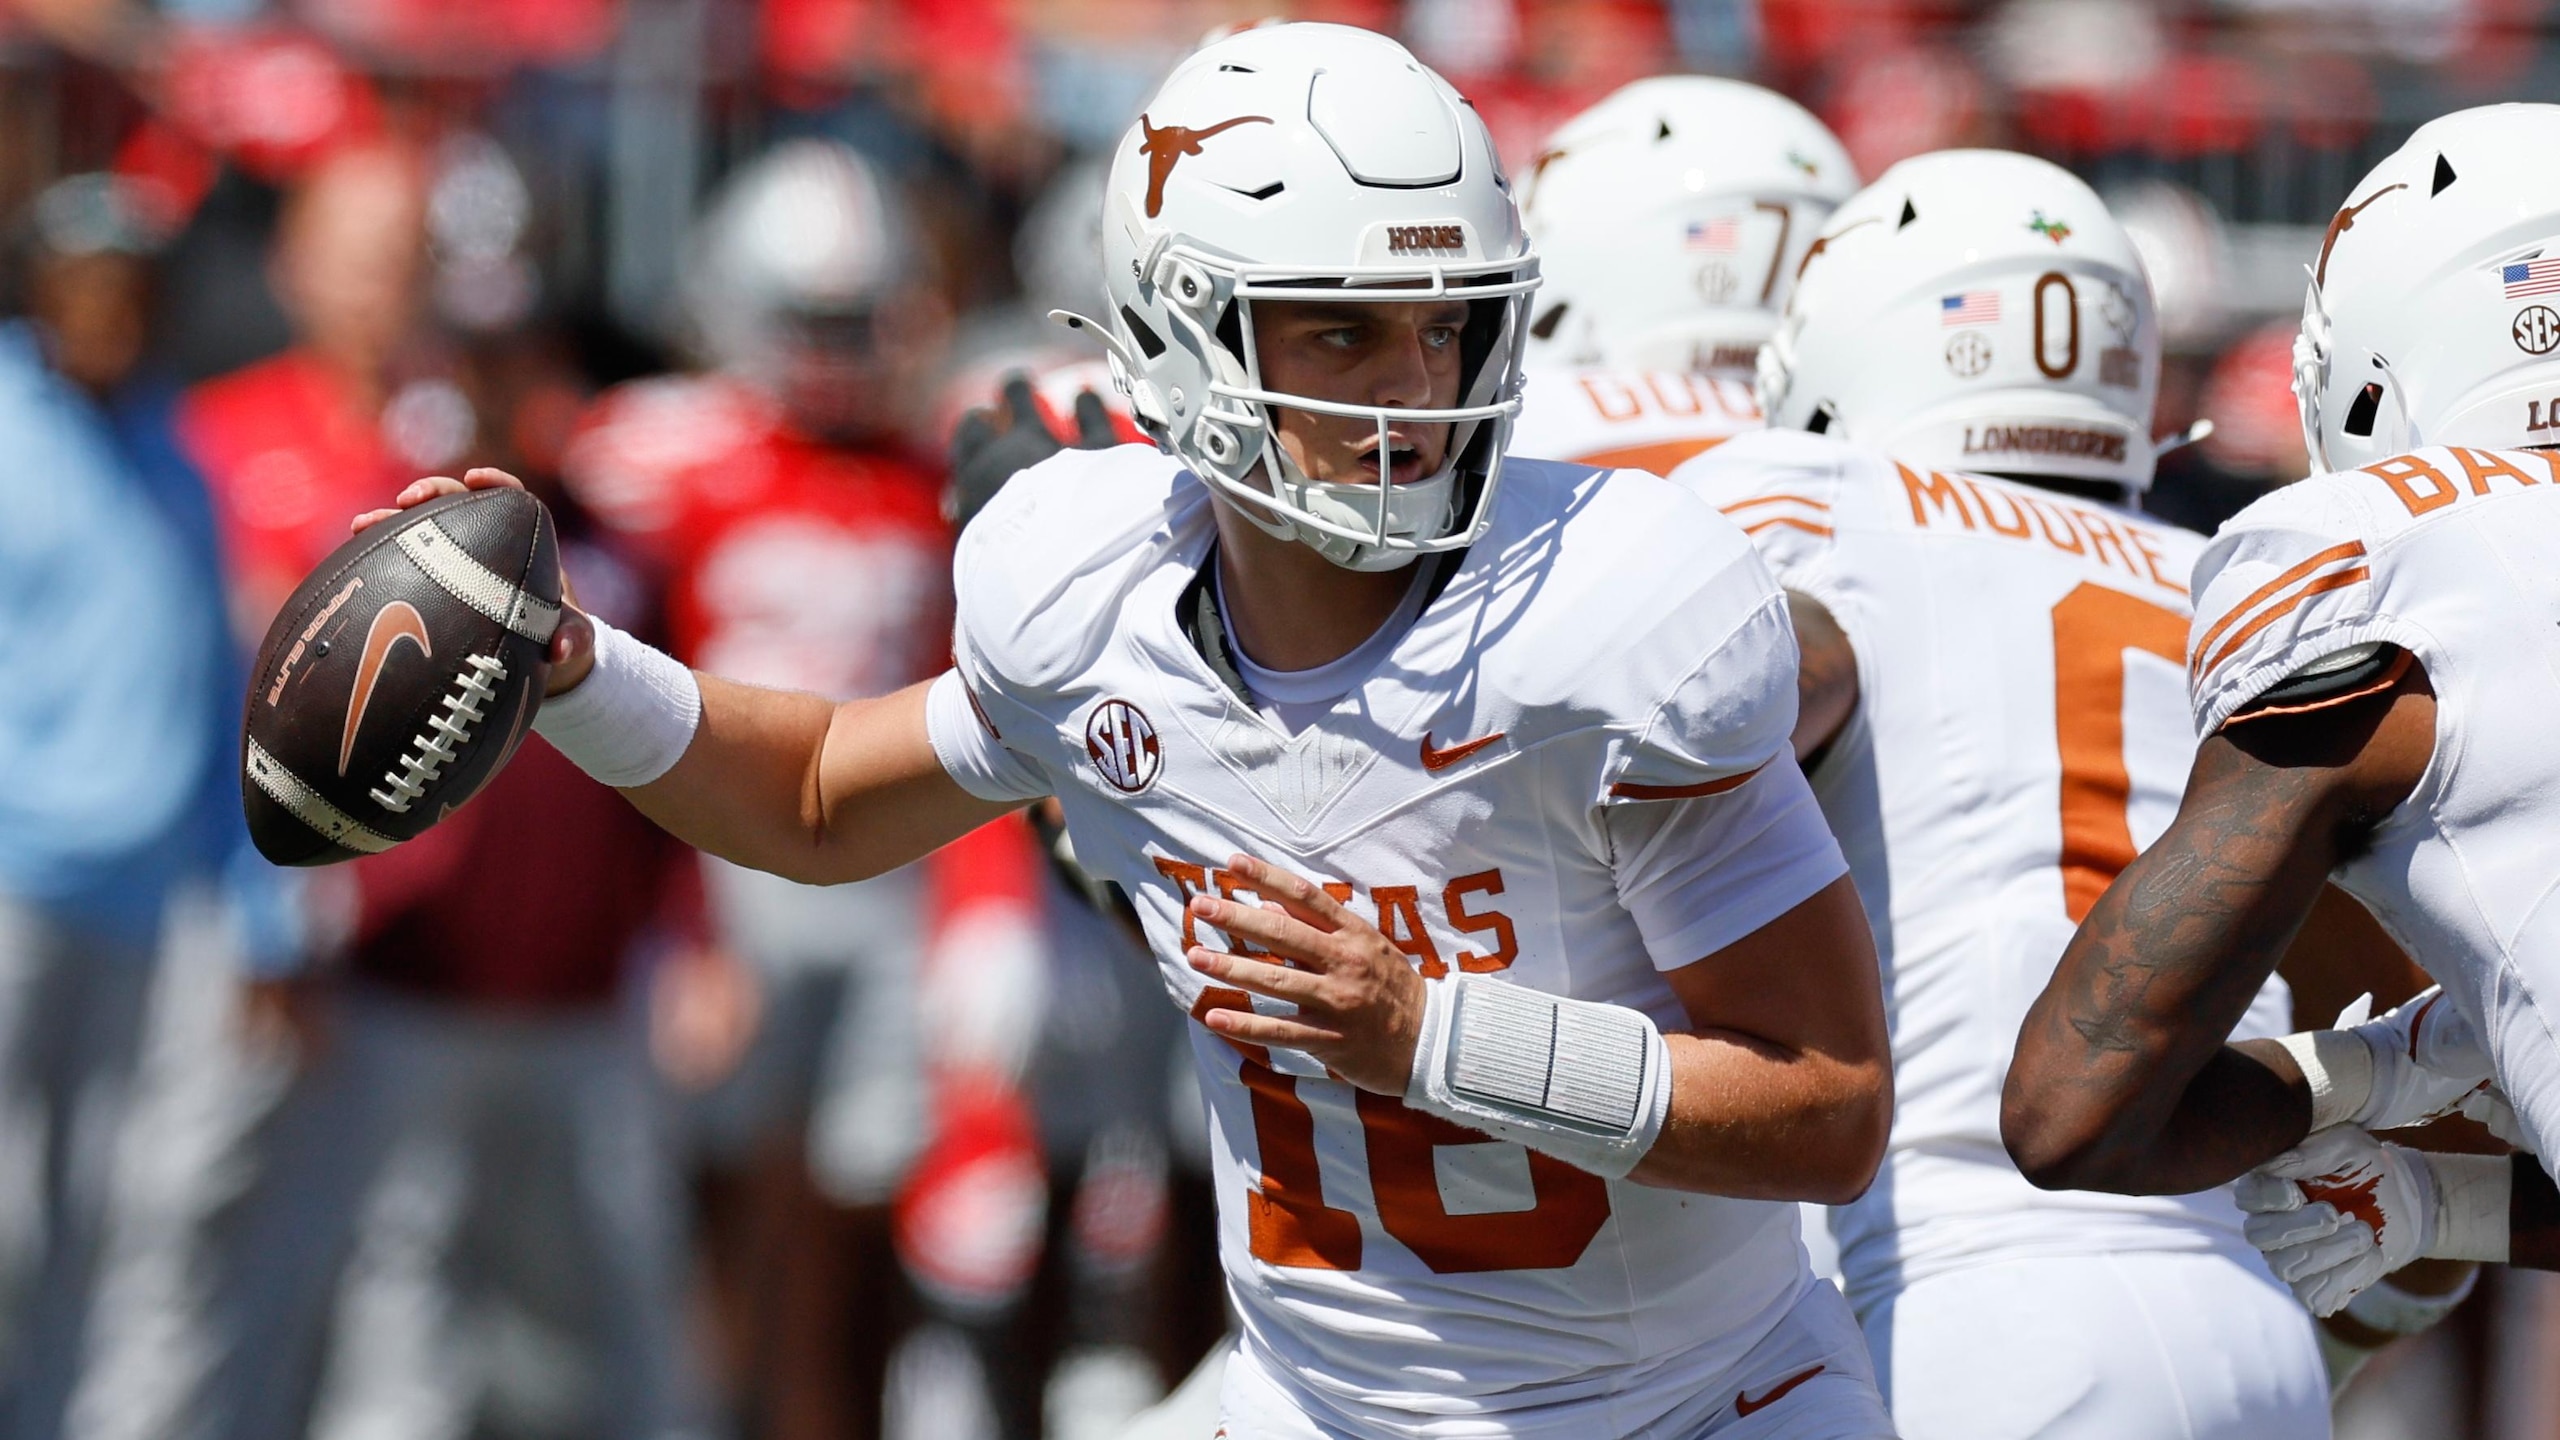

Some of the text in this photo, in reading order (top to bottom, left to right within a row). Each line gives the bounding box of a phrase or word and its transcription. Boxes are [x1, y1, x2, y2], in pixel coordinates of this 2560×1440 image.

[1387, 226, 1464, 250] HORNS
[1753, 201, 1790, 306] 7
[2033, 271, 2080, 380] 0
[2514, 306, 2560, 354] SEC
[1893, 460, 2190, 597] MOORE
[267, 576, 364, 708] VAPOR ELITE
[1088, 701, 1158, 790] SEC
